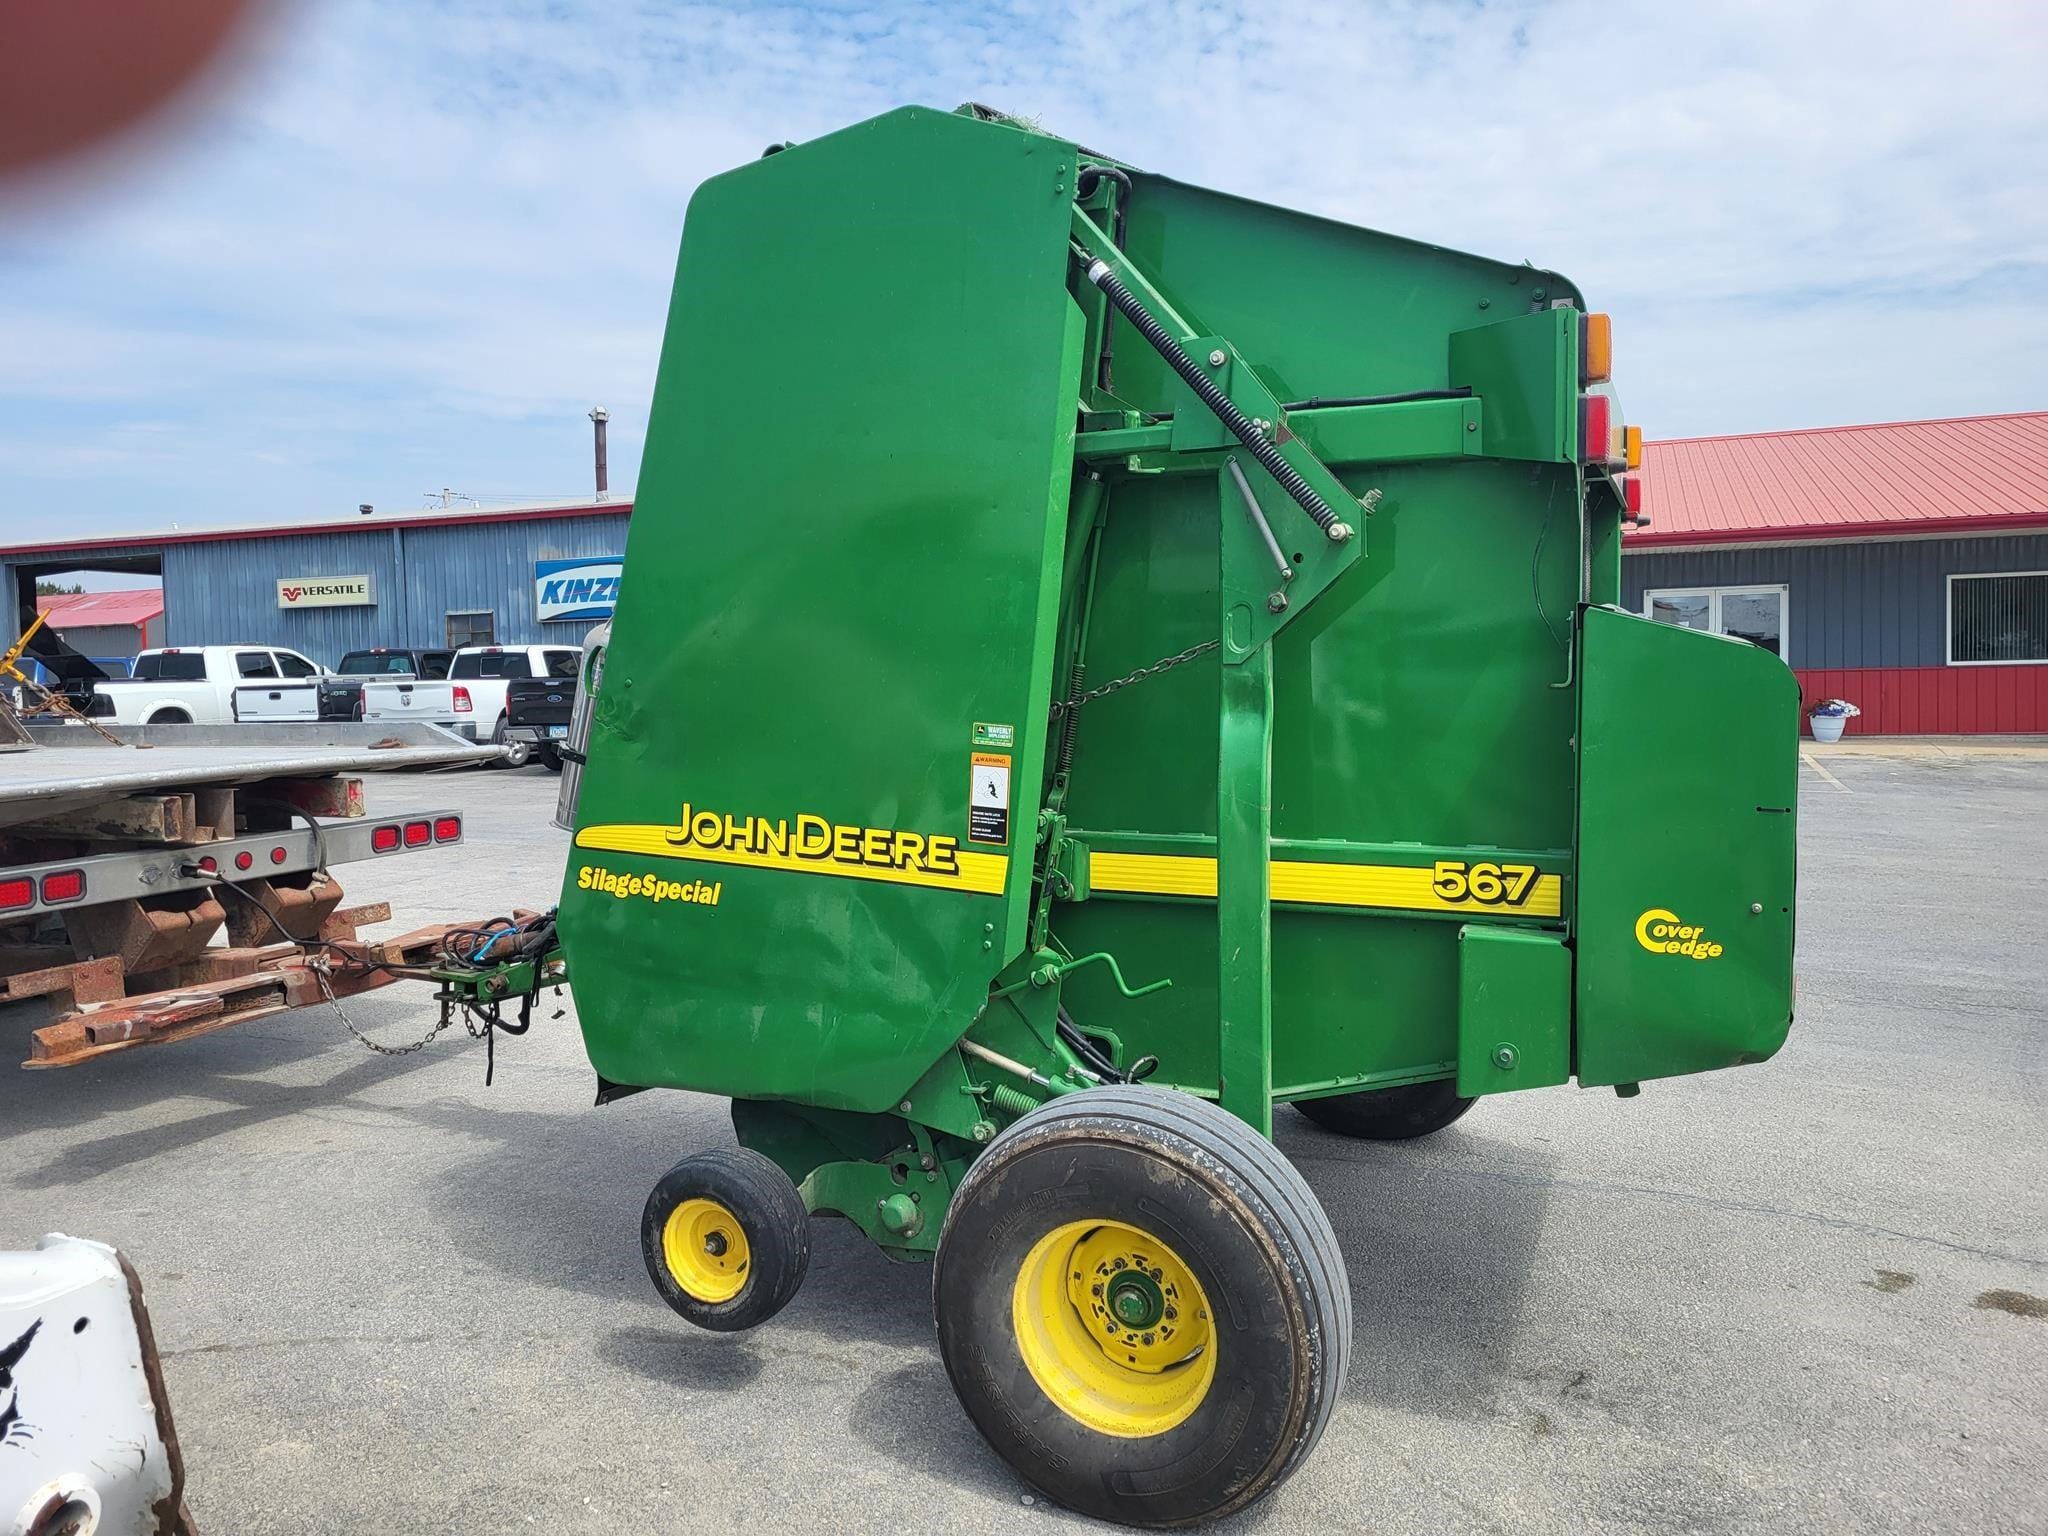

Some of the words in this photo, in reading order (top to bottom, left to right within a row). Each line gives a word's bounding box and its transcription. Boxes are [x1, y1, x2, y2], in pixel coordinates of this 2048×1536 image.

[302, 583, 365, 596] VERSATILE
[665, 802, 788, 856] JOHN
[795, 813, 960, 873] DEERE
[1432, 861, 1540, 905] 567
[1635, 908, 1705, 953] Cover
[1665, 939, 1724, 960] edge
